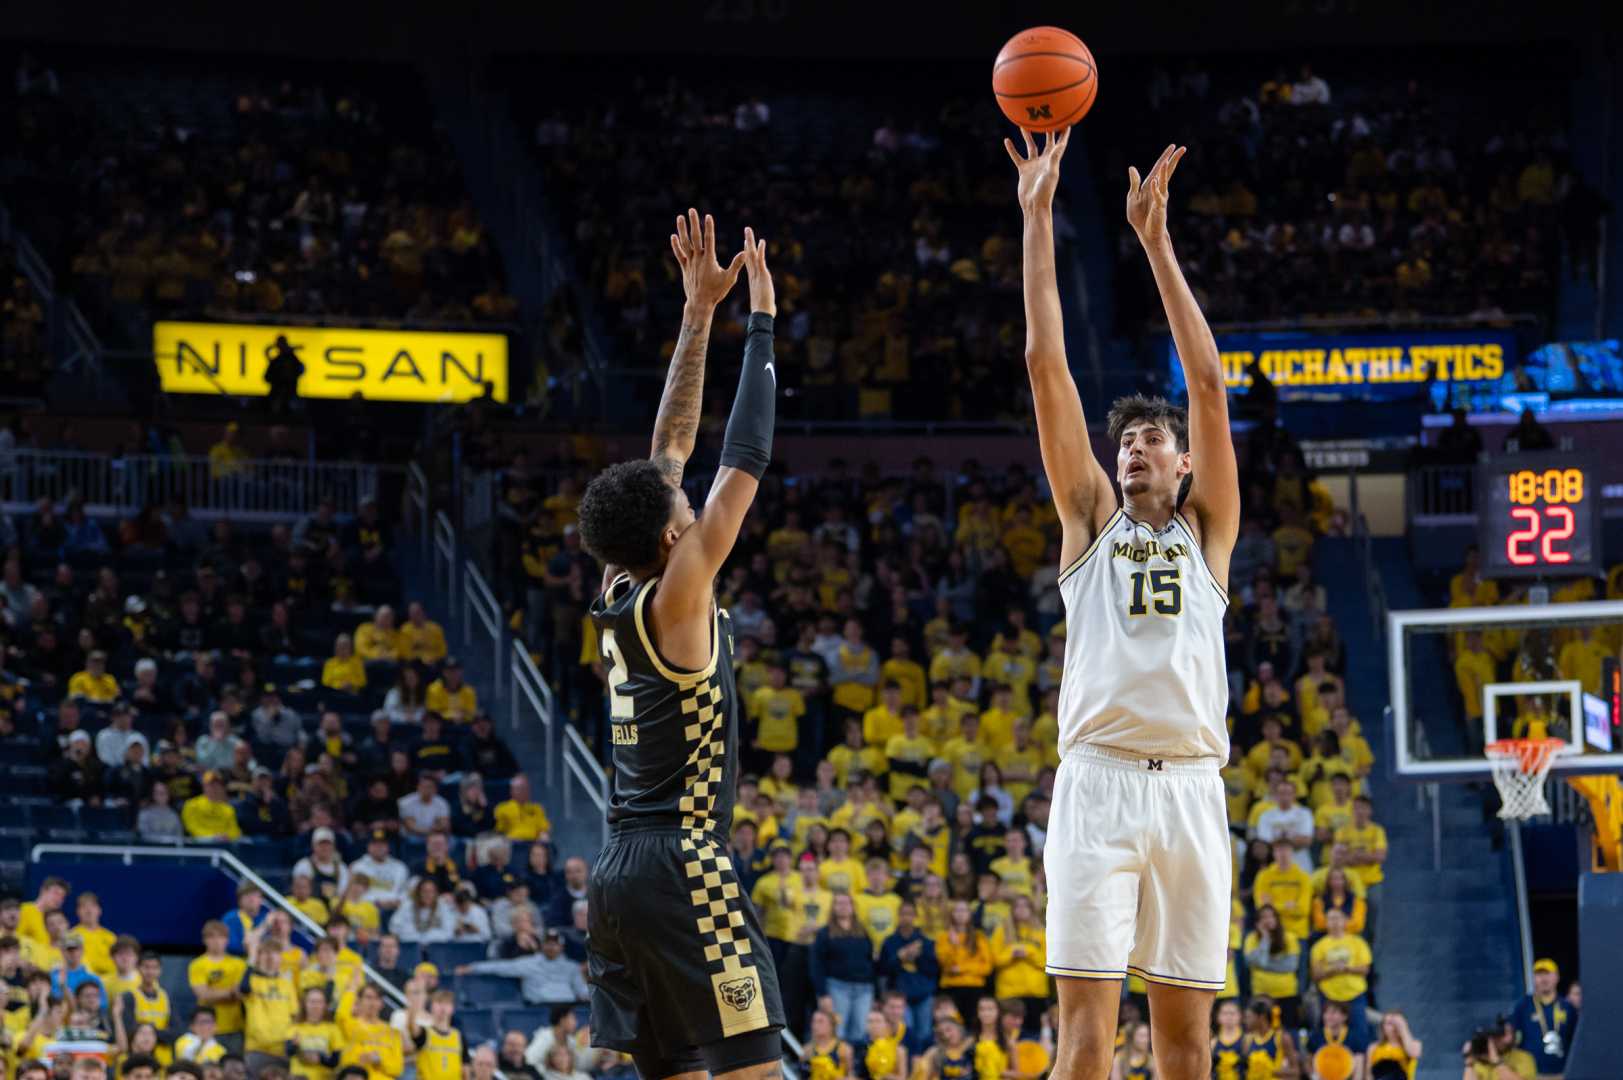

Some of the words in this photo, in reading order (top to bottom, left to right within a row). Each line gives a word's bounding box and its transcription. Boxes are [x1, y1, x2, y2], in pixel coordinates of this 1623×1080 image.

[175, 339, 482, 386] NISAN
[1509, 468, 1584, 505] 18:08
[1112, 540, 1189, 562] MICHIAN
[1506, 506, 1575, 564] 22
[1128, 568, 1184, 617] 15
[602, 628, 635, 719] 2
[1147, 758, 1164, 771] M
